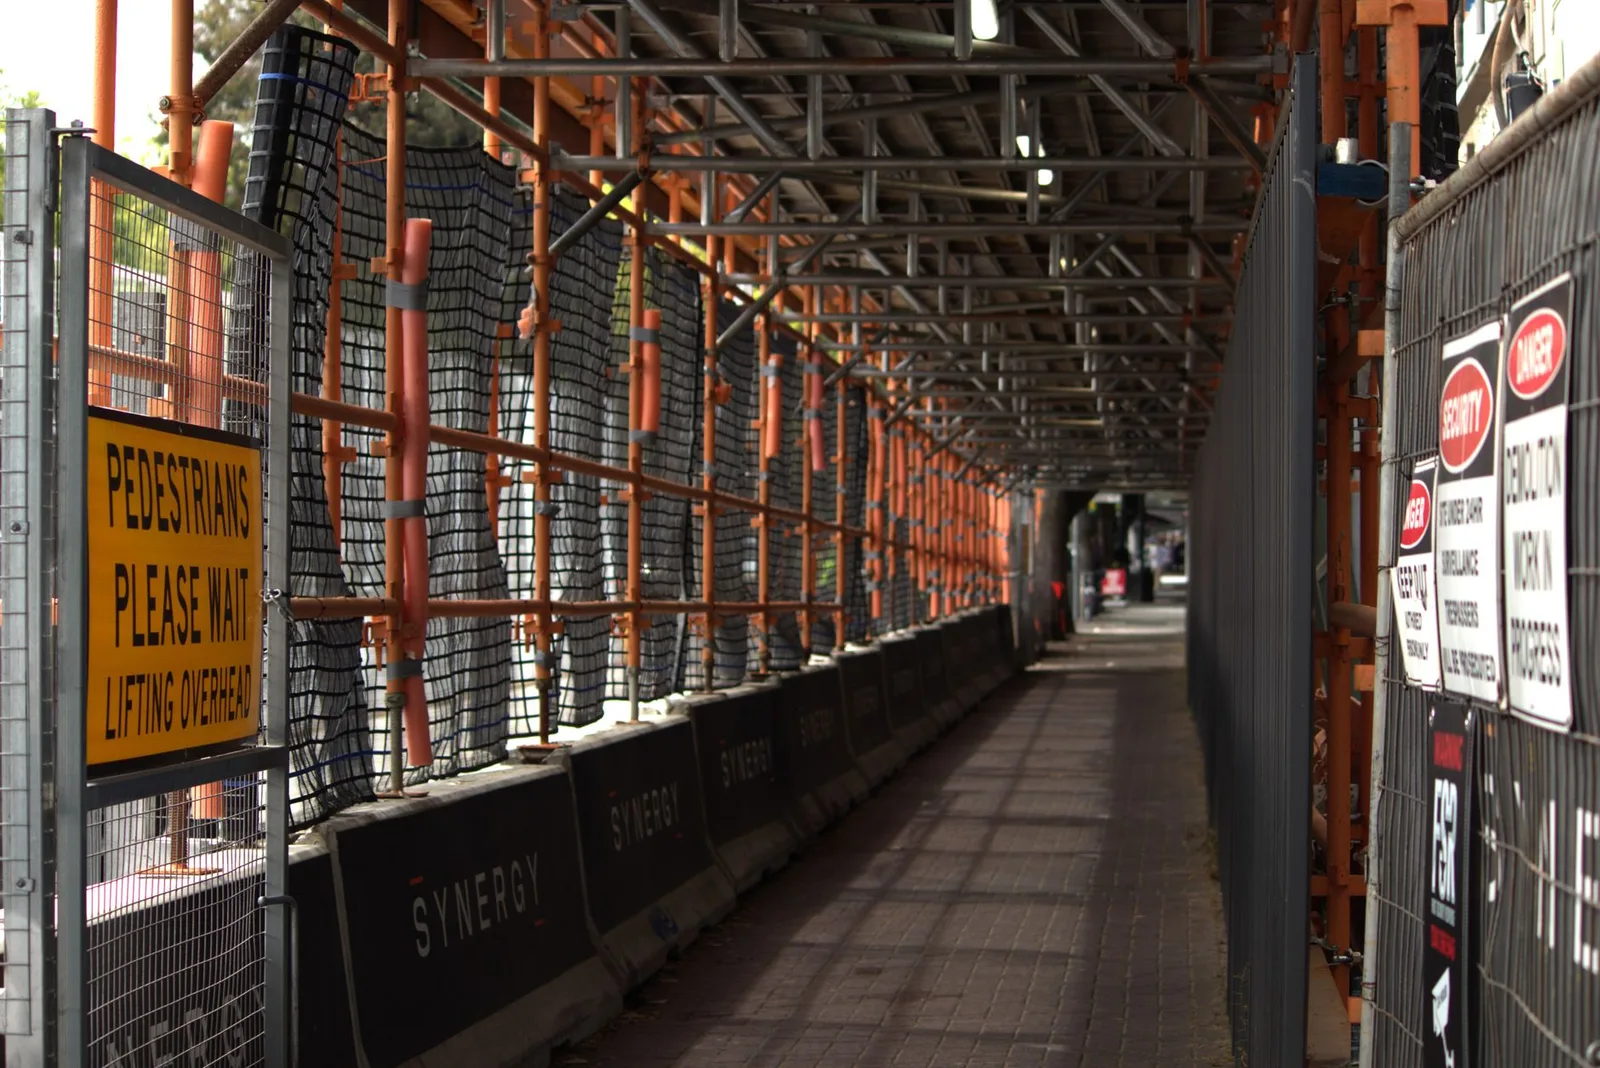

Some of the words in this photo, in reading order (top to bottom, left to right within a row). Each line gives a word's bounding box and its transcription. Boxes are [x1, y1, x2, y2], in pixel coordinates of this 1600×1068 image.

[1516, 323, 1553, 385] DANGER
[1442, 388, 1483, 441] SECURITY
[106, 442, 250, 539] PEDESTRIANS
[1506, 435, 1561, 504] DEMOLITION
[1403, 496, 1425, 530] NGER
[1512, 530, 1541, 590] WORK
[1543, 529, 1553, 590] IN
[114, 562, 201, 648] PLEASE
[207, 567, 249, 643] WAIT
[1510, 616, 1562, 687] PROGRESS
[104, 670, 174, 740] LIFTING
[180, 664, 251, 730] OVERHEAD
[719, 736, 773, 788] SYNERGY
[611, 781, 680, 852] SYNERGY
[1431, 777, 1459, 905] FSR
[411, 851, 540, 958] SYNERGY
